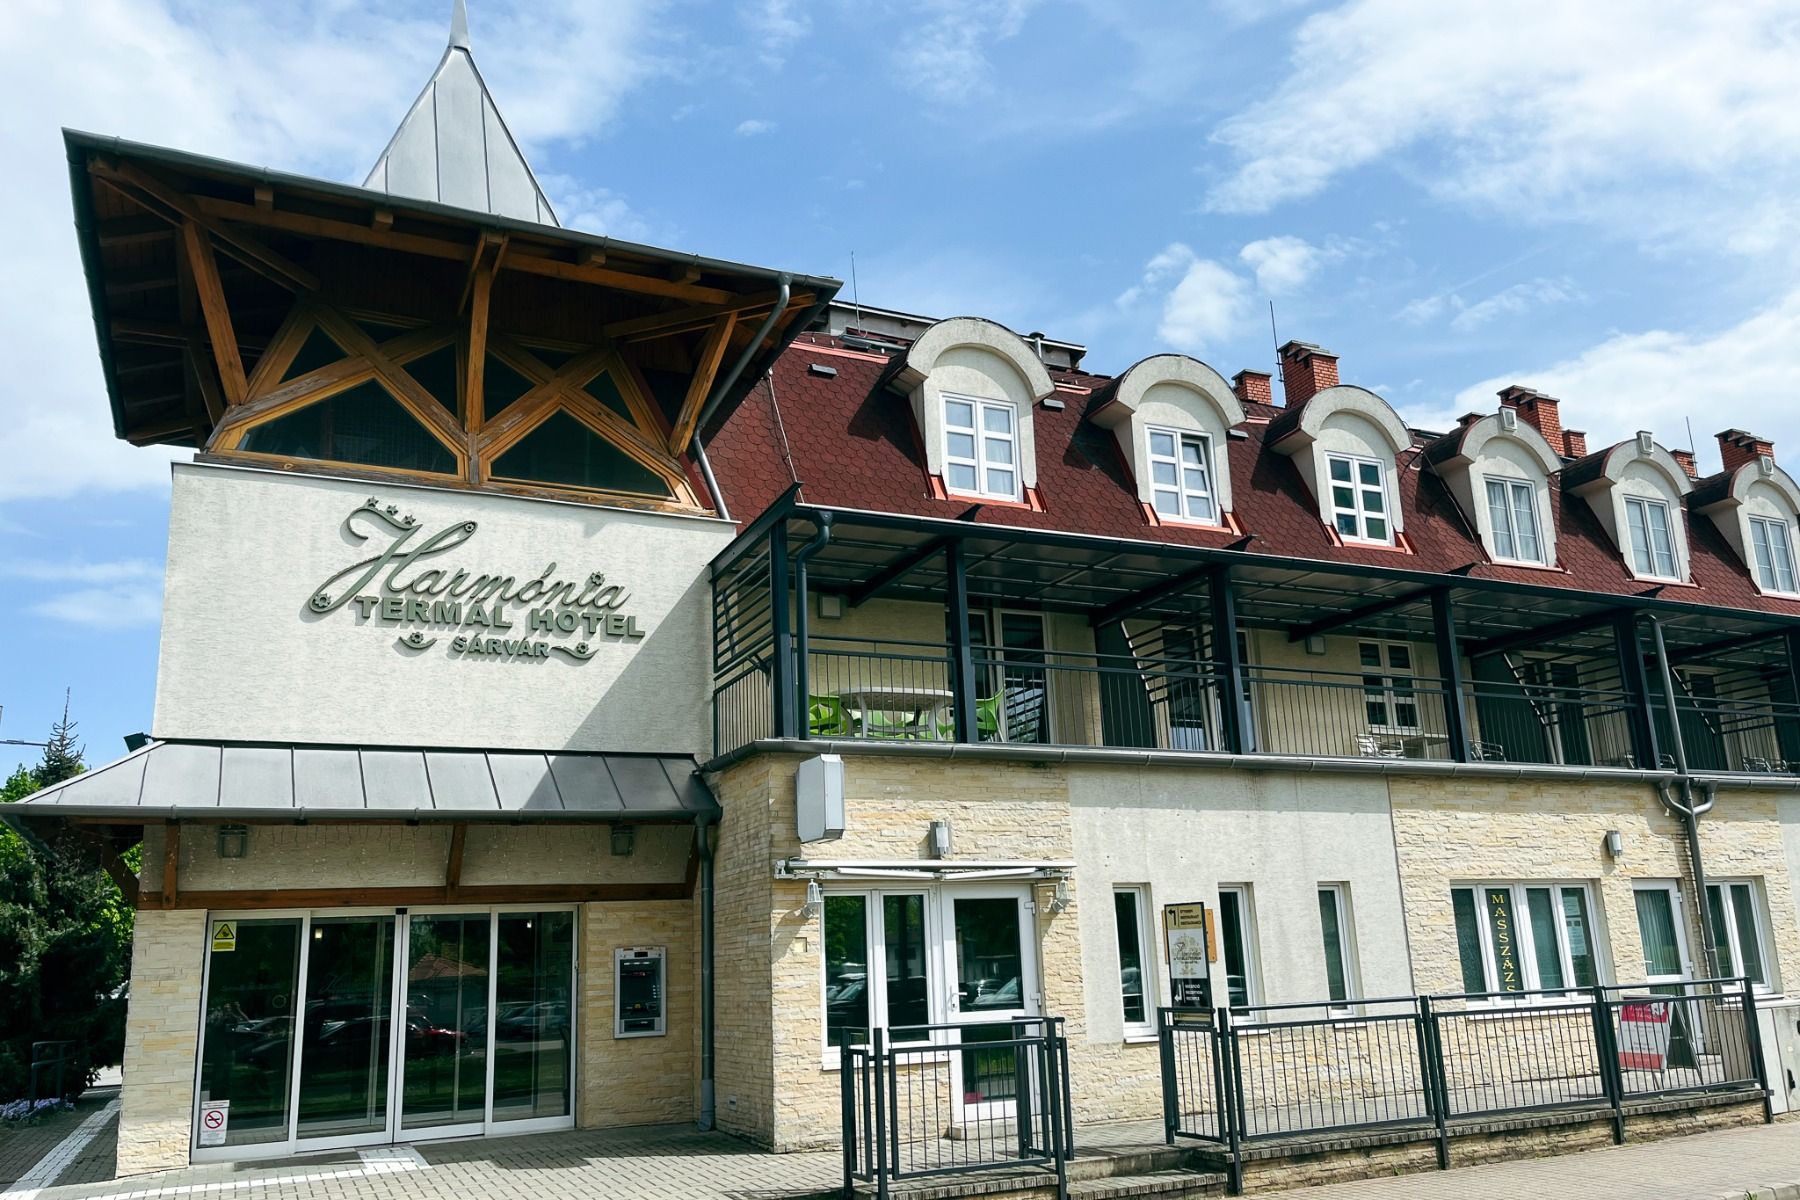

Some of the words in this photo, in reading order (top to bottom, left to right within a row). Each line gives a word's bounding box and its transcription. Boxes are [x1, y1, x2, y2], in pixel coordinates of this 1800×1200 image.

[308, 505, 632, 613] Harmónia
[532, 608, 646, 638] HOTEL
[453, 633, 550, 658] SÁRVÁR
